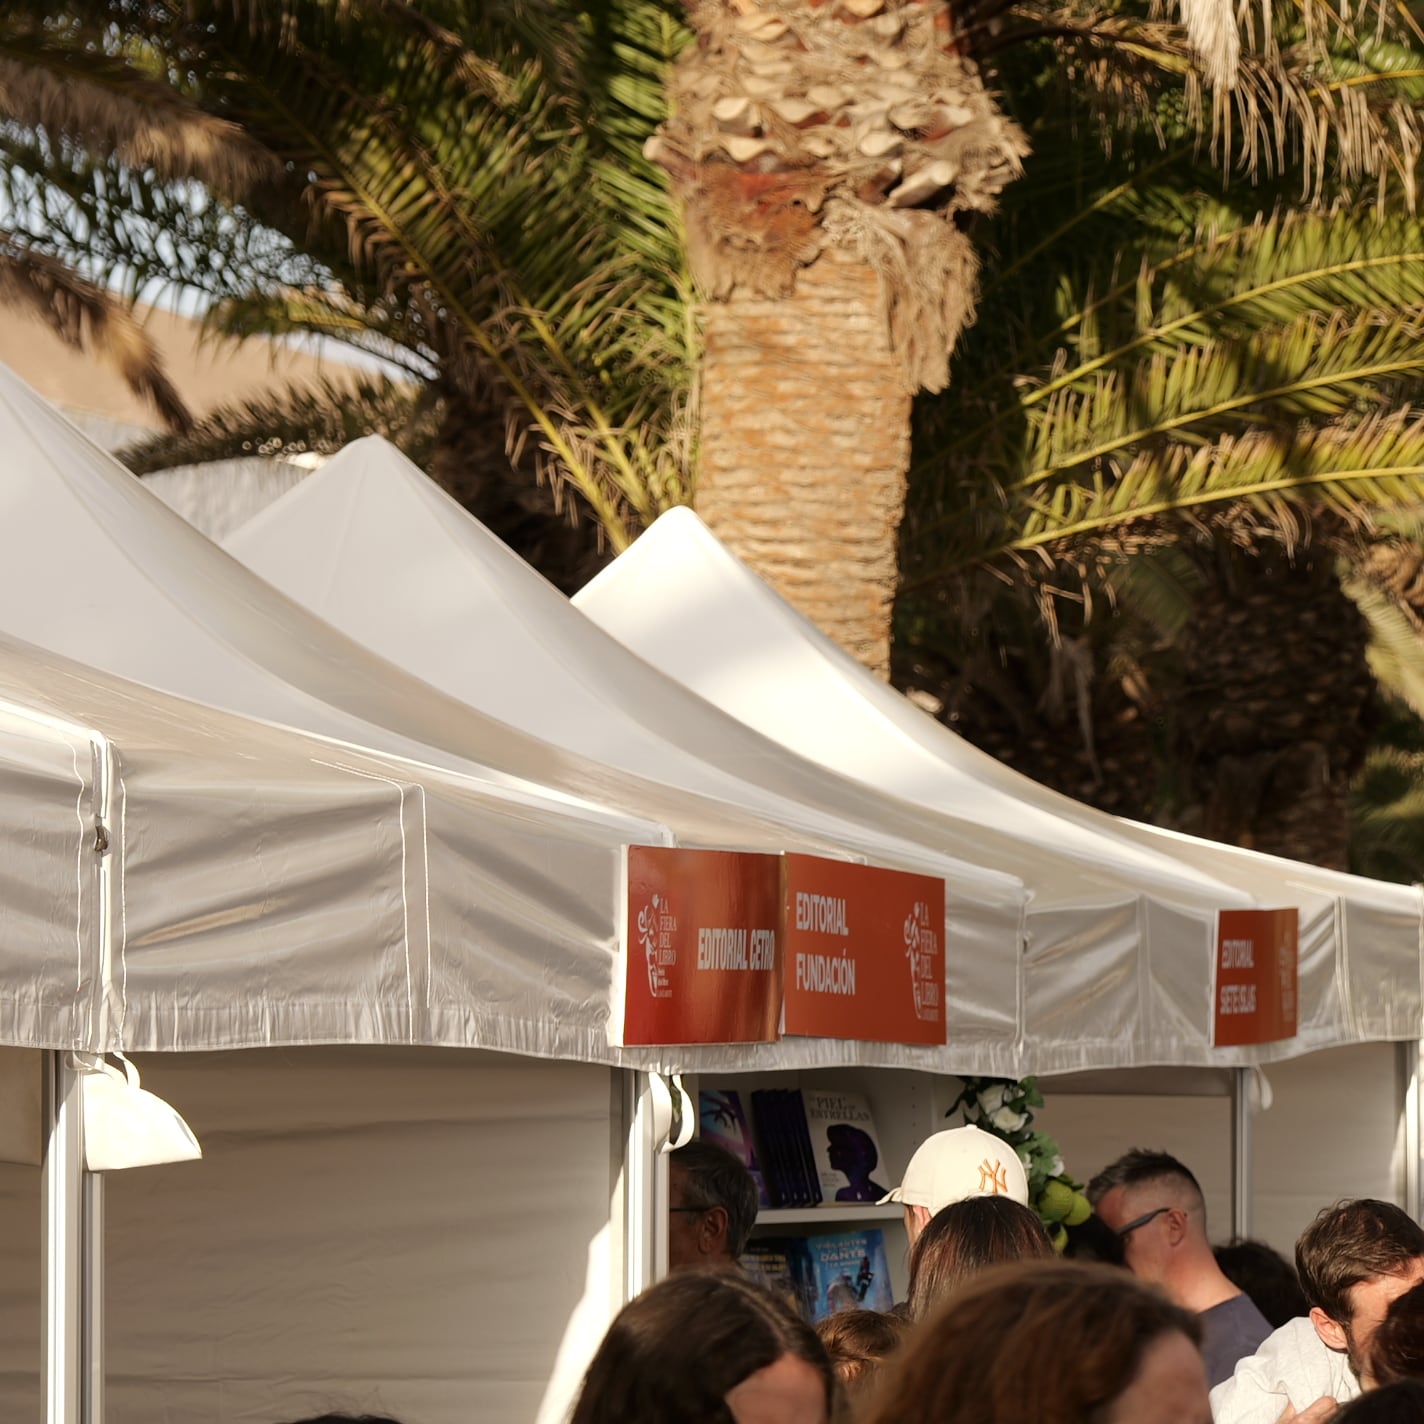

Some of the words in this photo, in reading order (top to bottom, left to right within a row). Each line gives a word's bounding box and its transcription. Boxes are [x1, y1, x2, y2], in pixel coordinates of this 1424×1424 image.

[796, 891, 849, 936] EDITORIAL
[697, 928, 748, 970] EDITORIAL
[749, 929, 775, 970] CETRO
[796, 947, 856, 996] FUNDACIÓN
